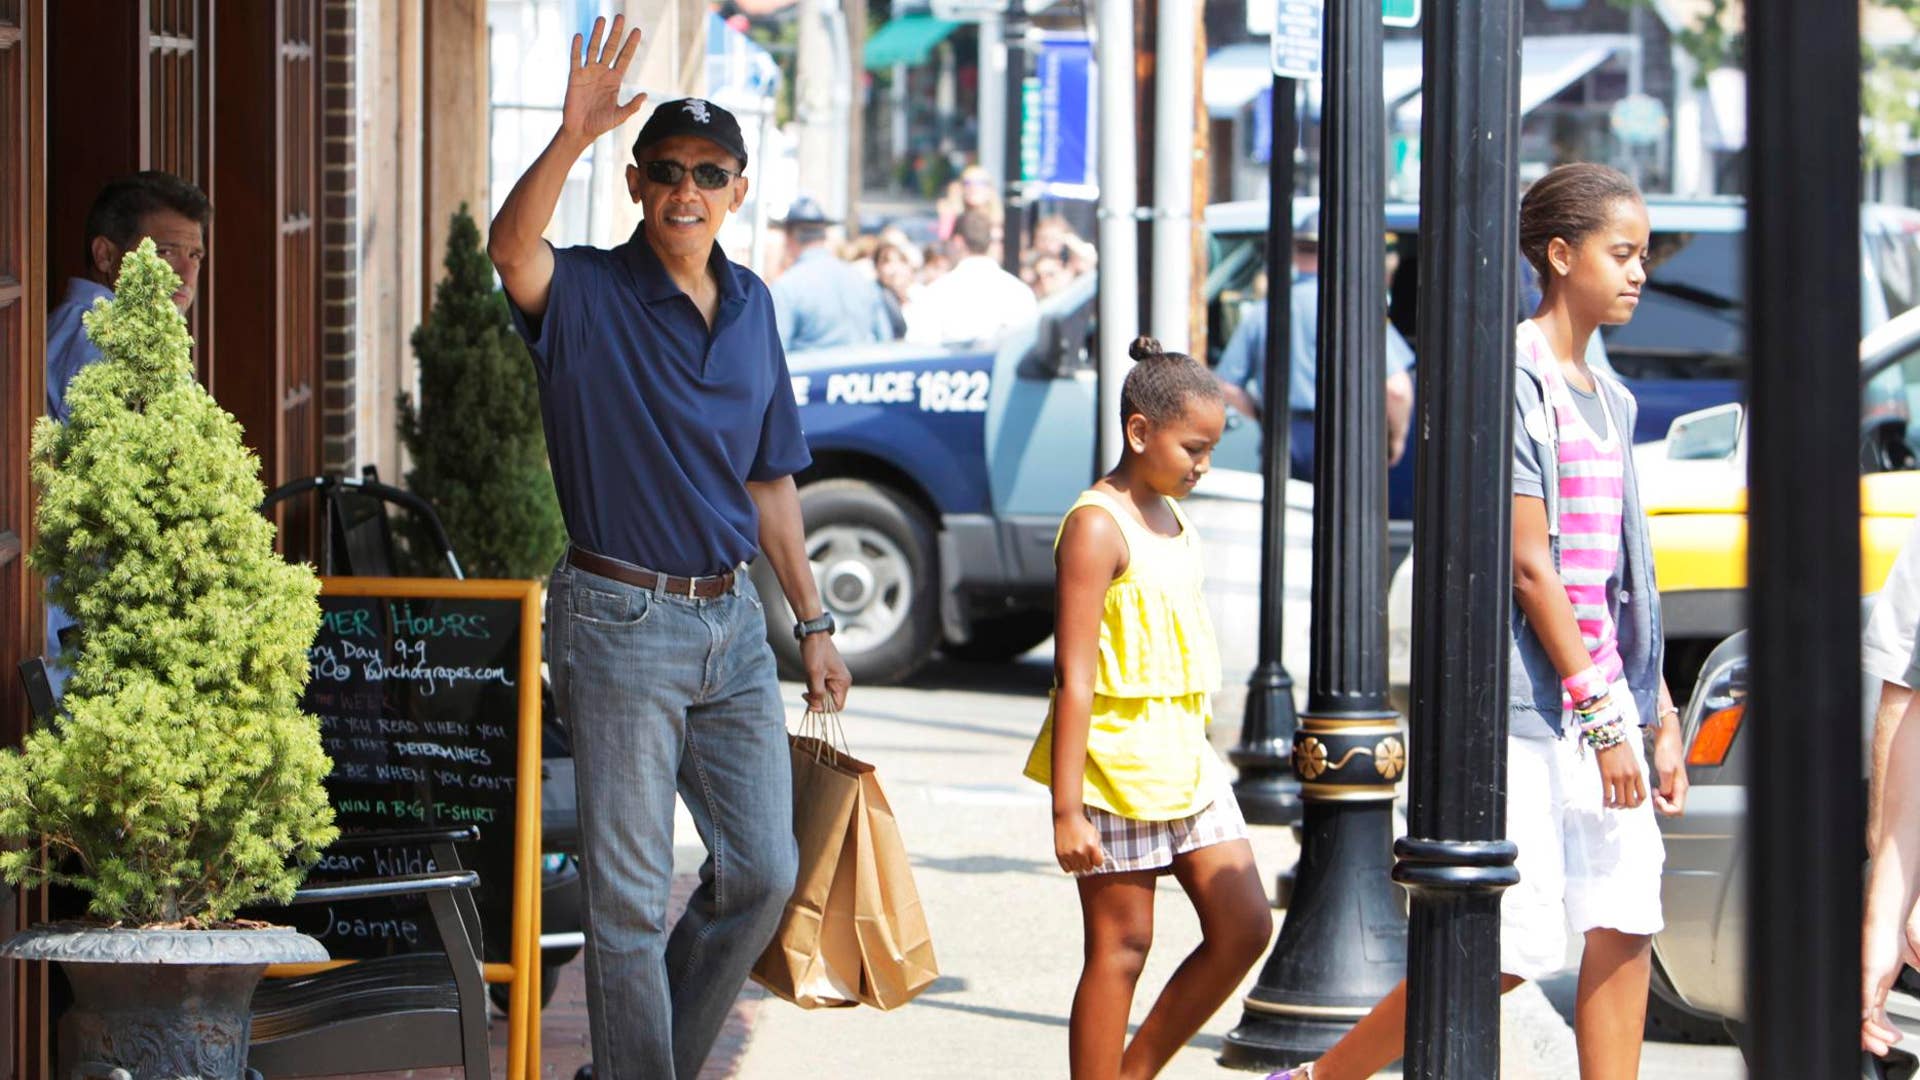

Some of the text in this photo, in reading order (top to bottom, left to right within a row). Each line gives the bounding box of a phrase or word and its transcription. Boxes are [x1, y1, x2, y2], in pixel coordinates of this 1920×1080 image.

[826, 371, 916, 405] POLICE
[917, 370, 990, 412] 1622
[390, 602, 490, 638] HOURS
[340, 639, 382, 672] Day
[394, 639, 427, 664] 9-9
[363, 662, 515, 696] bunchofgrapes.com
[376, 718, 418, 735] READ
[423, 720, 469, 737] WHEN
[476, 722, 506, 740] YOU
[350, 737, 389, 753] THAT
[394, 741, 492, 765] DETERMINES
[375, 764, 426, 782] WHEN
[435, 769, 463, 787] YOU
[469, 774, 515, 793] CAN'T
[338, 799, 371, 813] WIN
[376, 800, 387, 813] A
[433, 803, 497, 822] T-SHIRT
[296, 847, 437, 875] scar Wilde
[315, 906, 418, 943] Joanne
